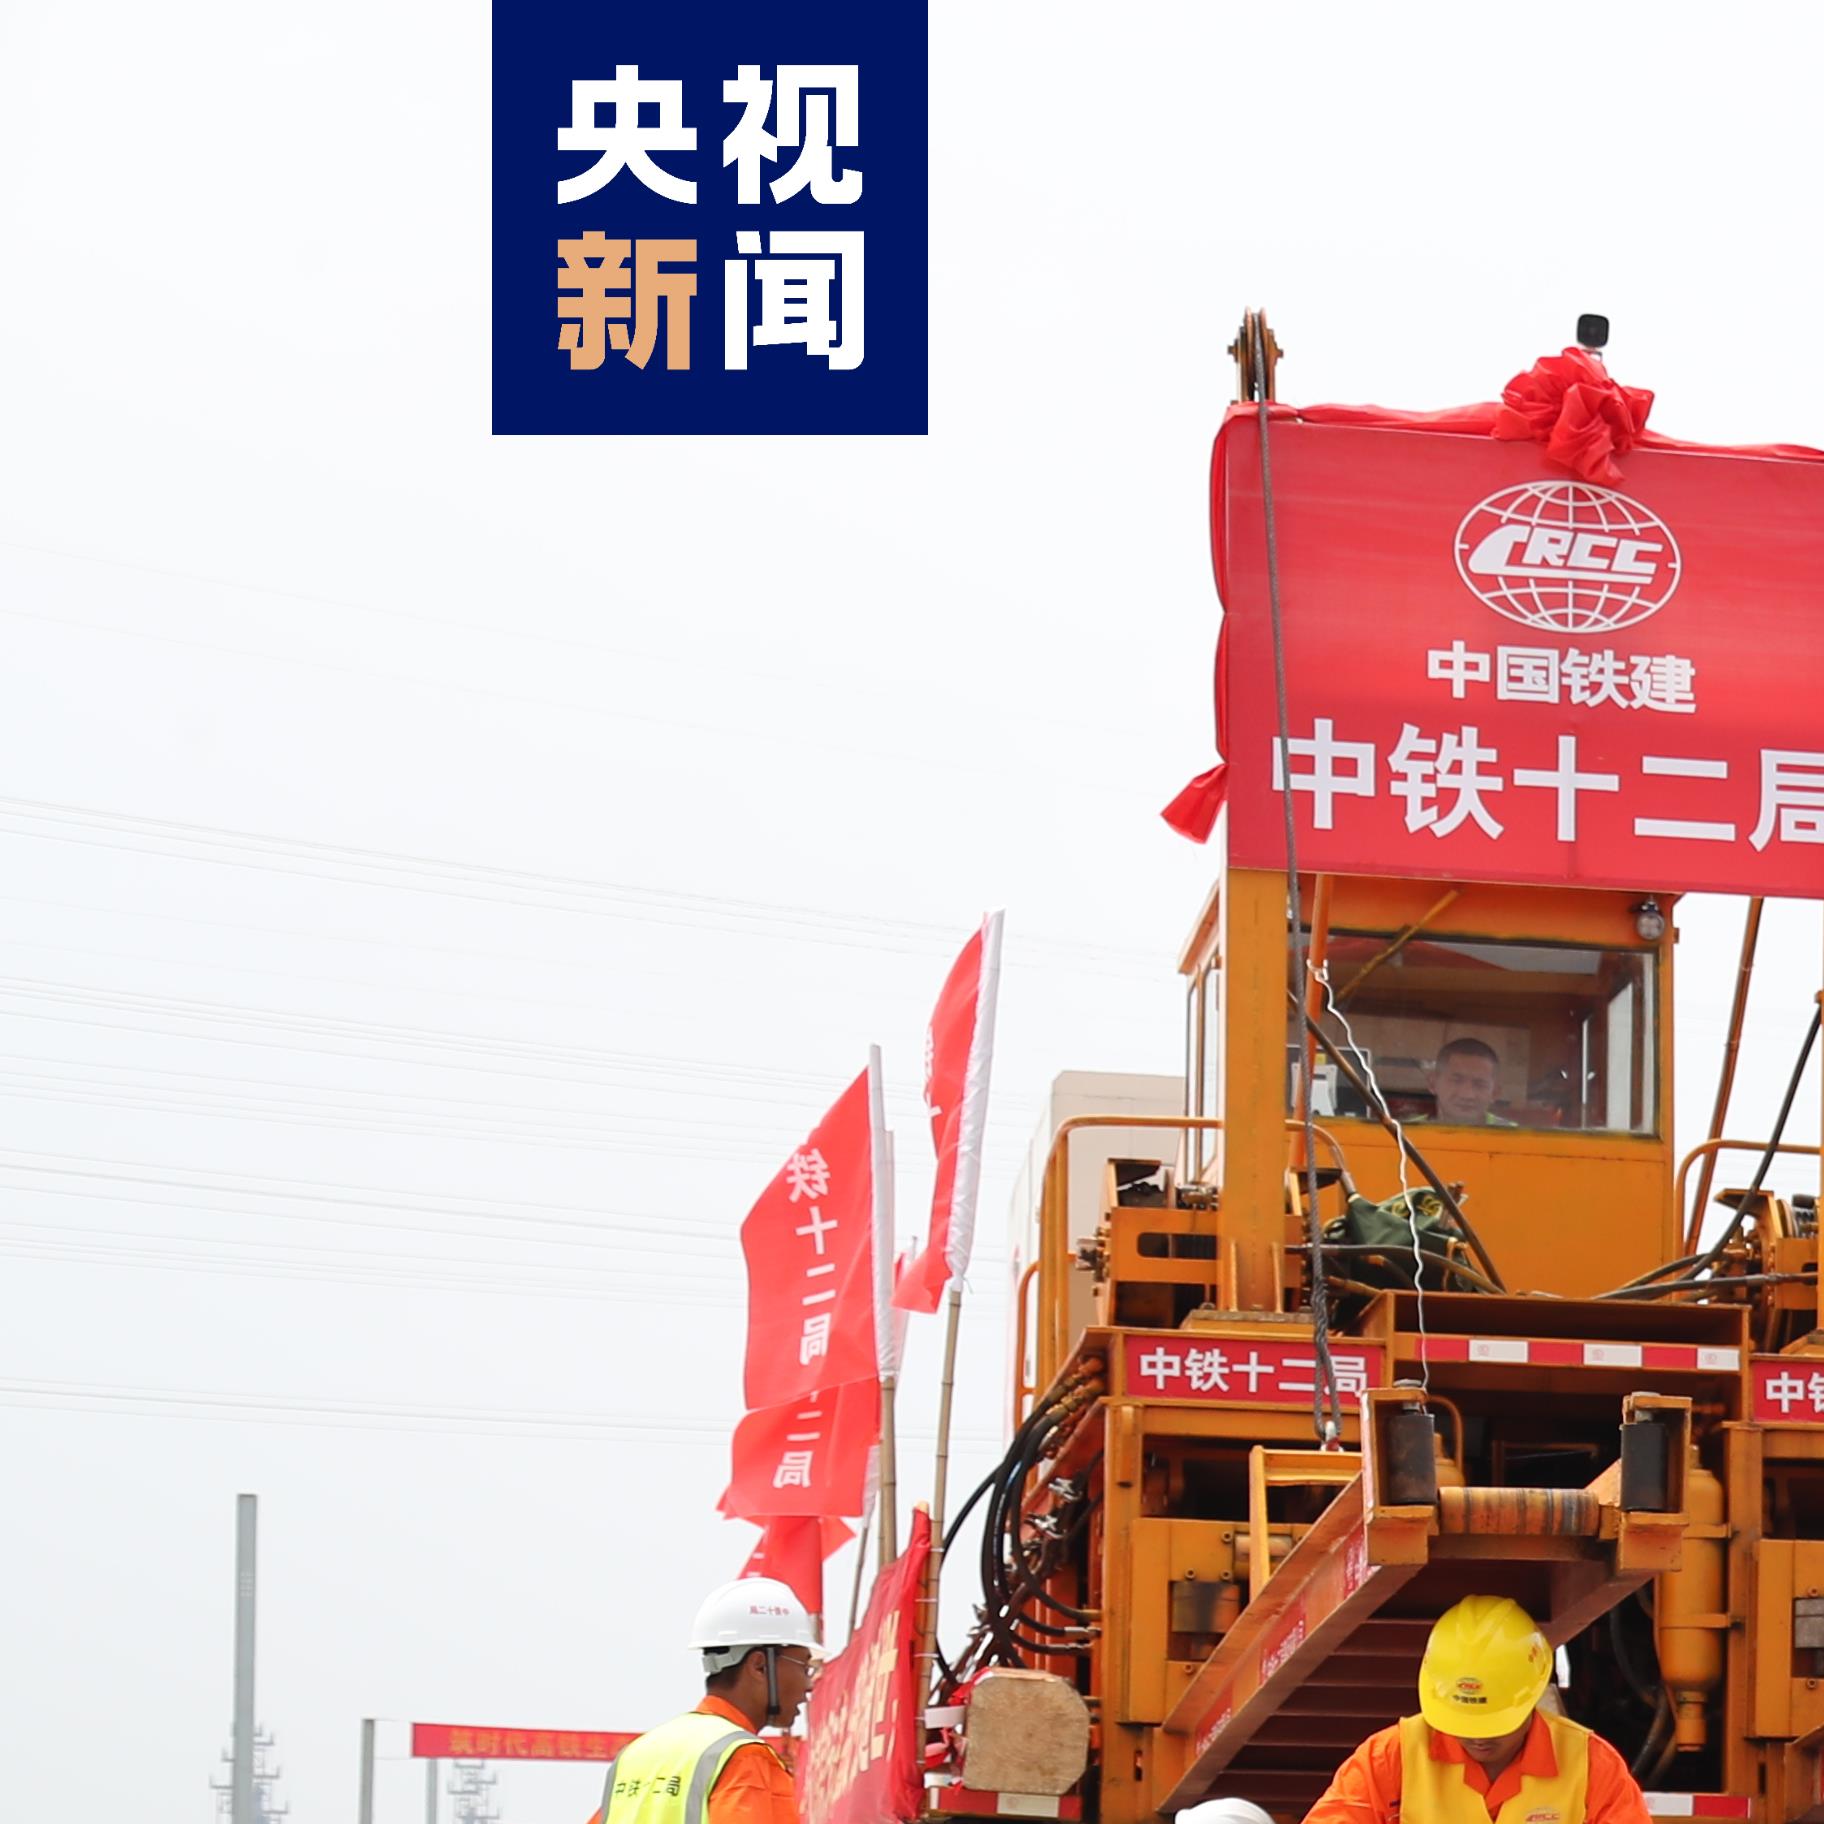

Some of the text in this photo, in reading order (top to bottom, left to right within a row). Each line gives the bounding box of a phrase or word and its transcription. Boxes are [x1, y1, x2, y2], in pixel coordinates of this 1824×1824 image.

[1468, 523, 1664, 585] CRCC
[1427, 639, 1697, 715] 中国铁建
[1139, 1346, 1371, 1395] 中铁十二局
